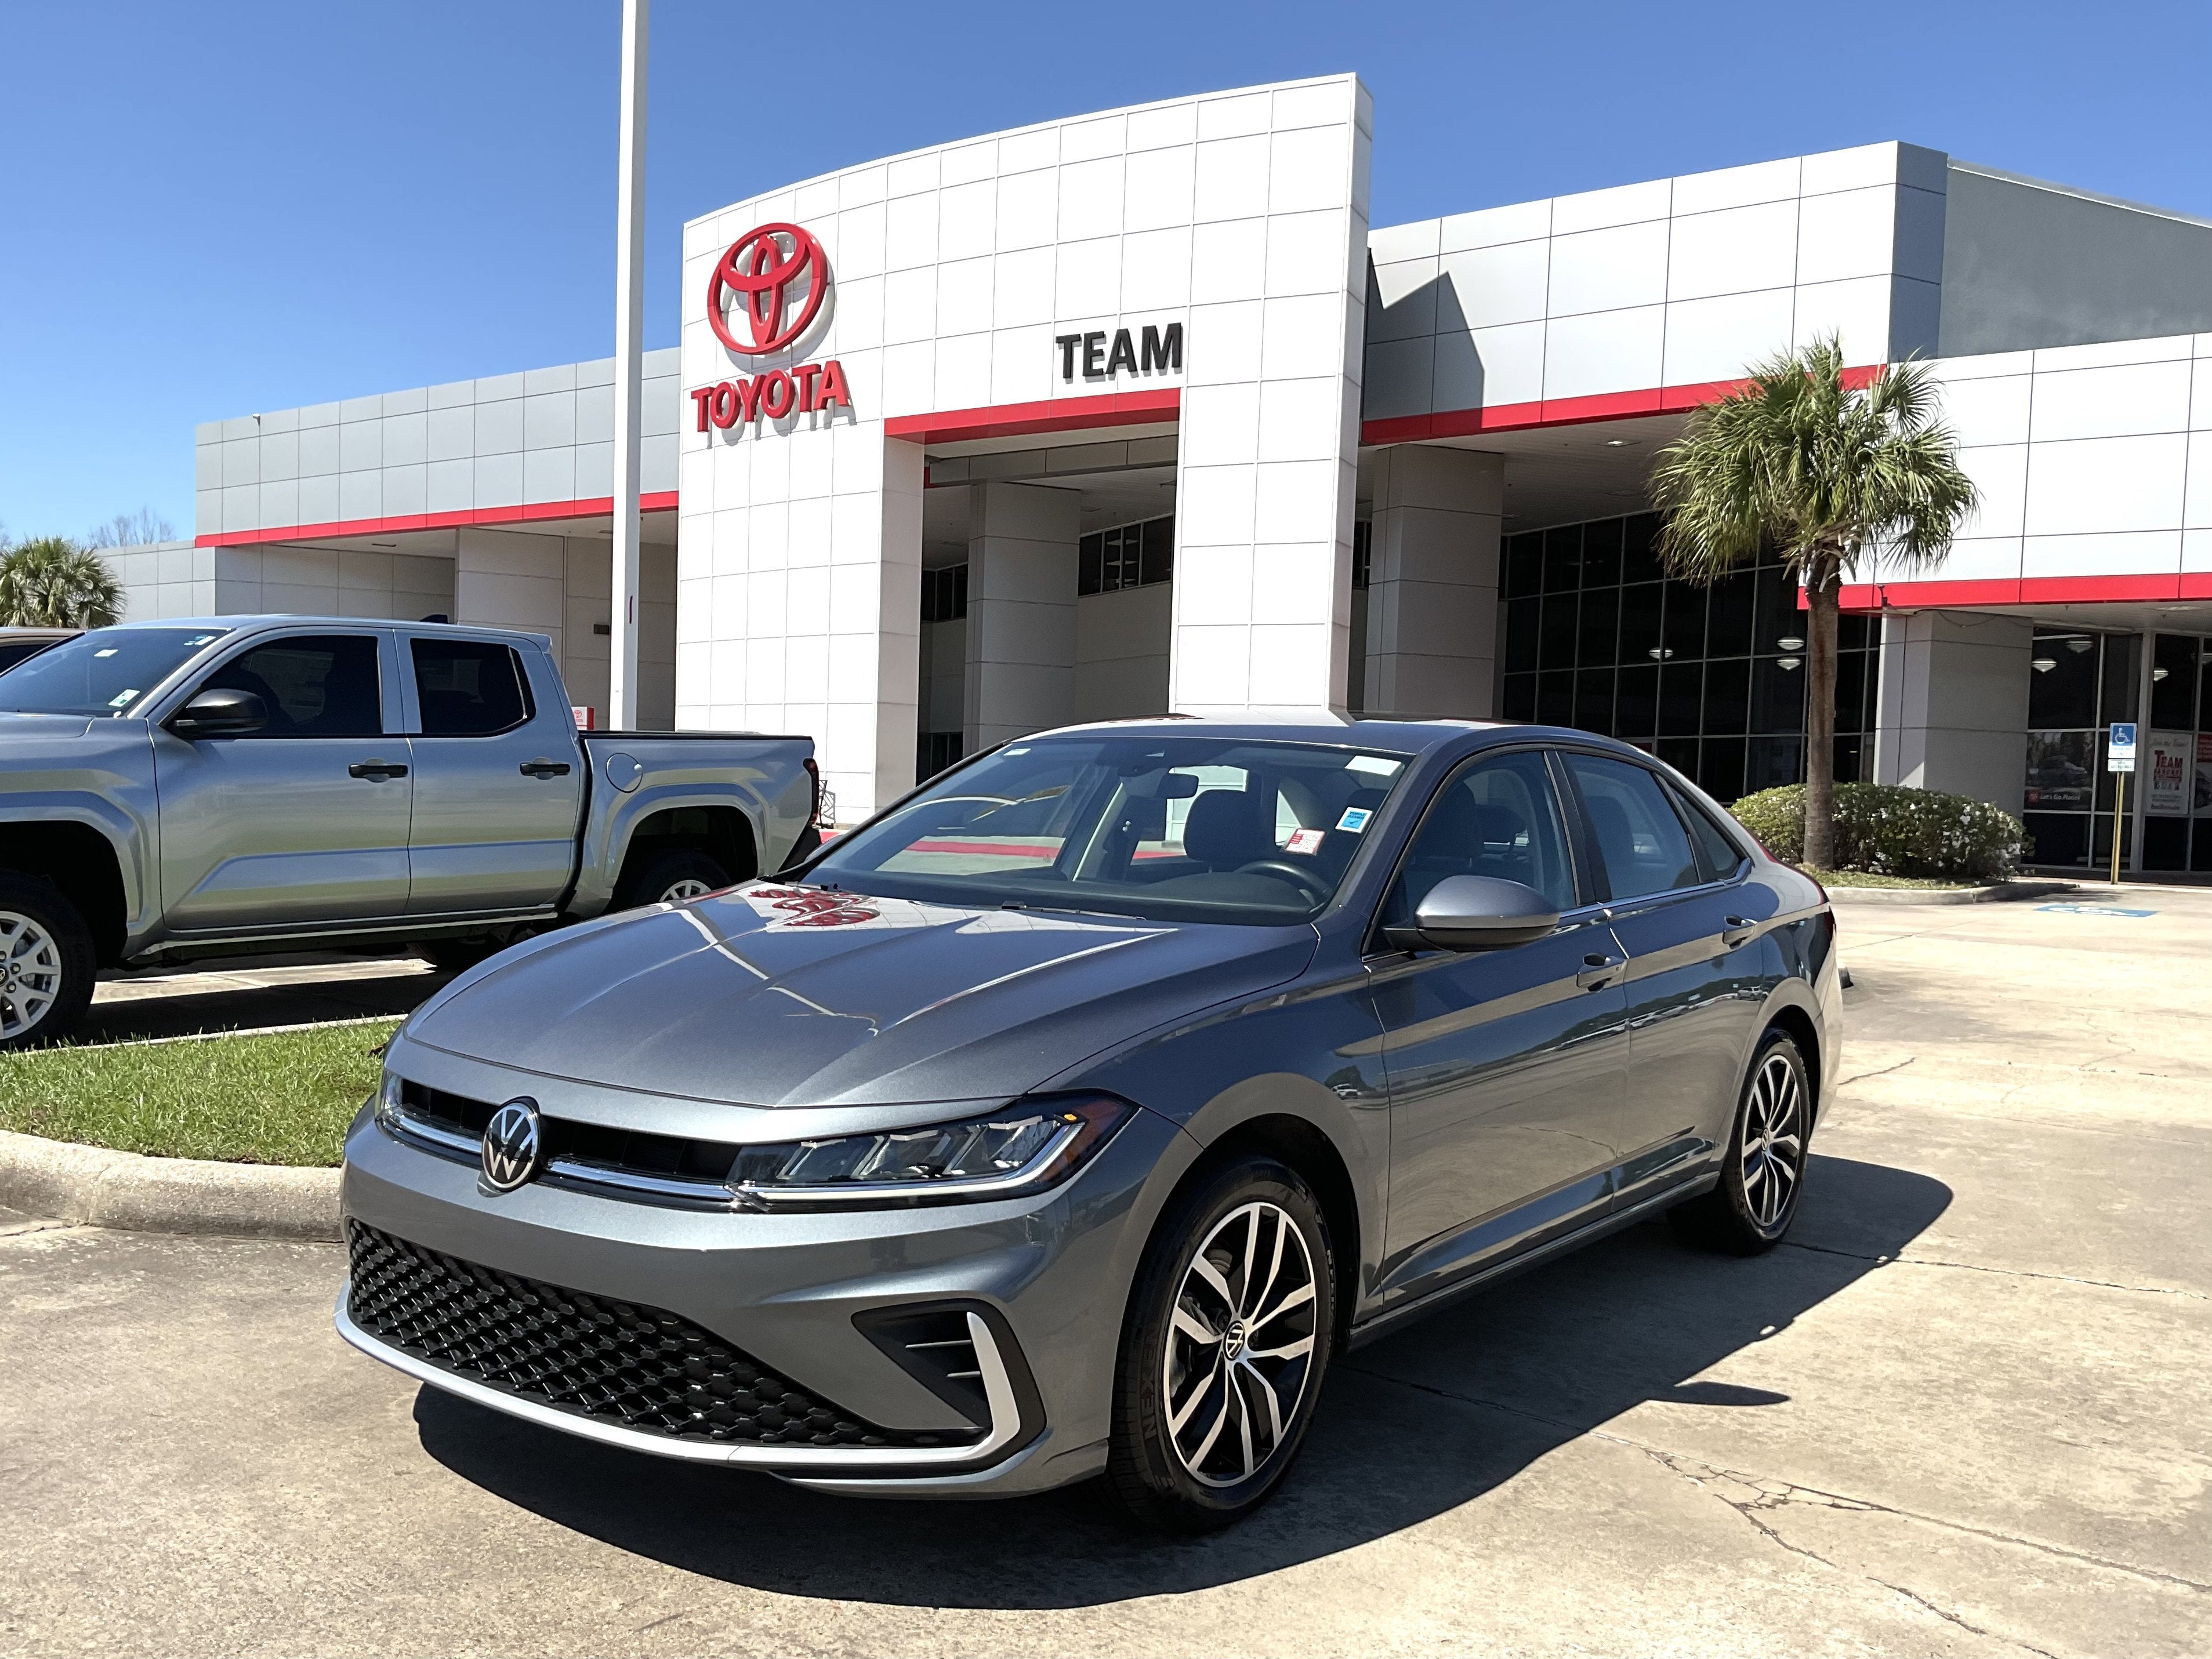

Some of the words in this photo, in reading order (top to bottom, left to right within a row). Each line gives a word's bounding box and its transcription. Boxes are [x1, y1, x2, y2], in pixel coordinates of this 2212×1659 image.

[1055, 322, 1183, 379] TEAM
[691, 360, 851, 432] TOYOTA
[2154, 750, 2183, 768] TEAM
